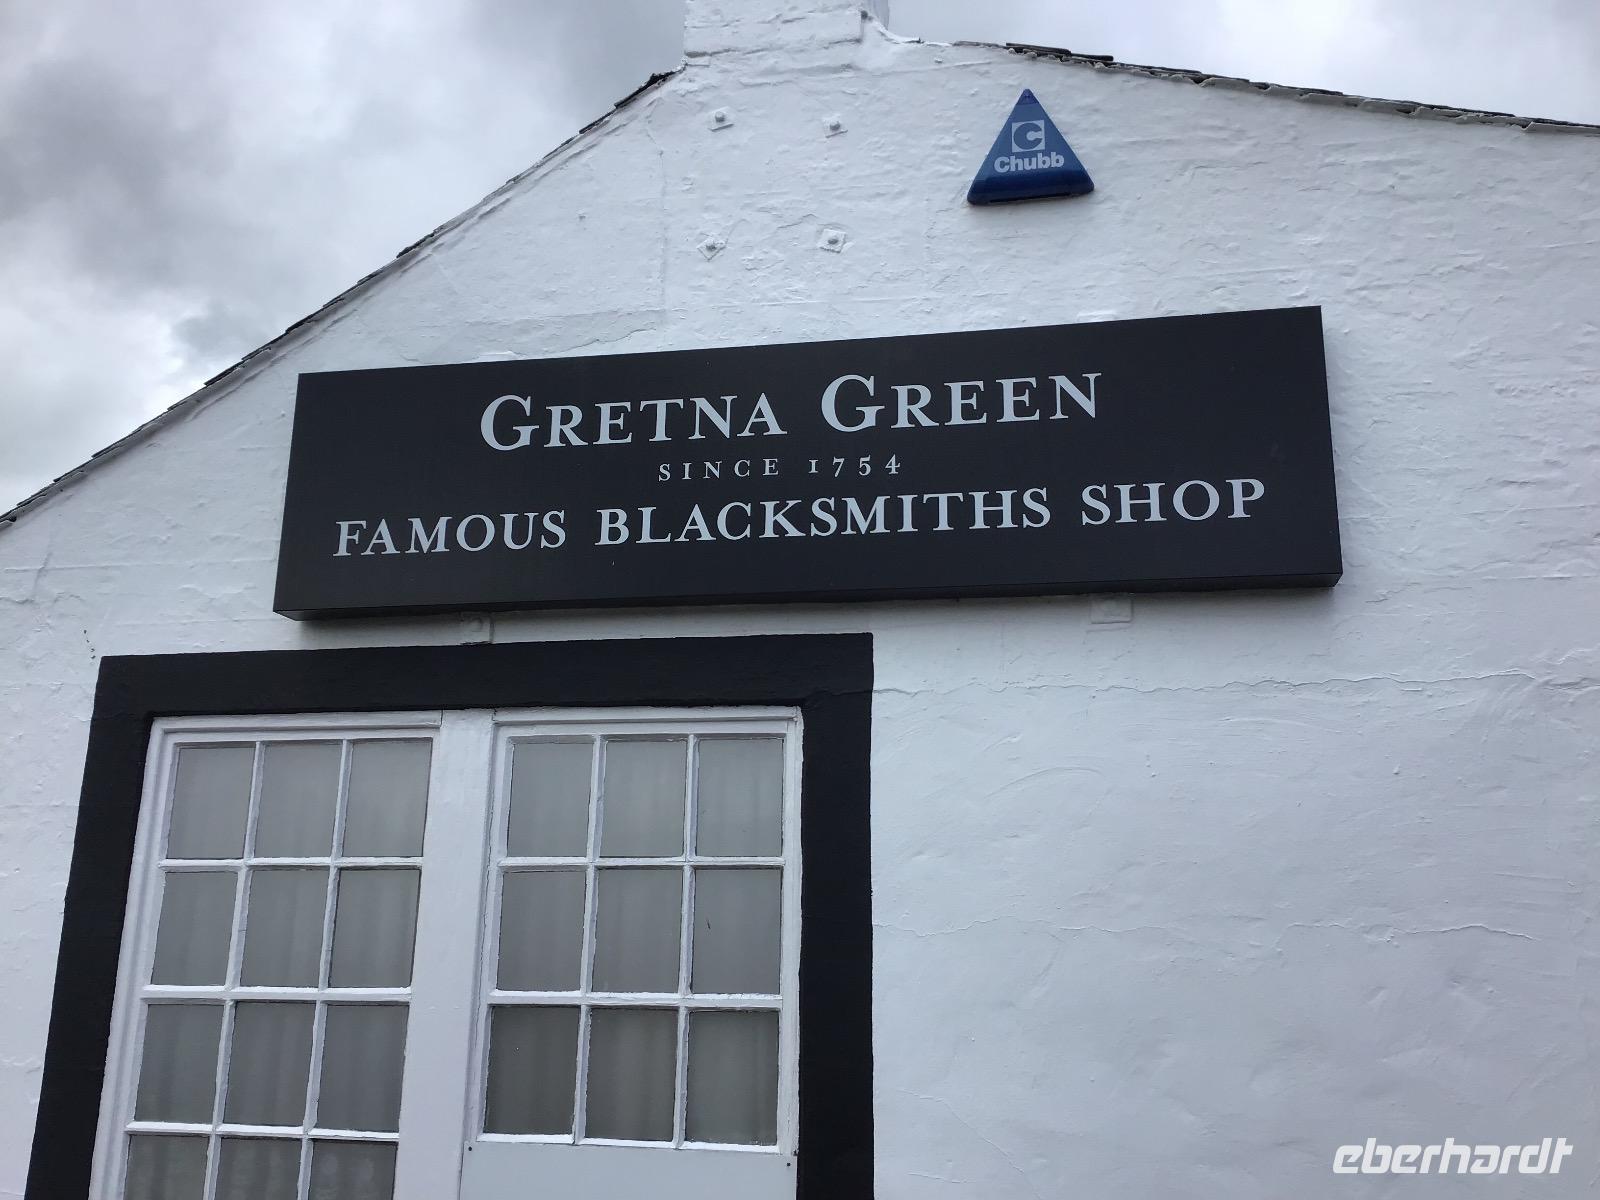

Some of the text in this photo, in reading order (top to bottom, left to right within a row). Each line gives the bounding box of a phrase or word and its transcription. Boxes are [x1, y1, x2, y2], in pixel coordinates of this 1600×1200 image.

[994, 151, 1065, 173] Chubb
[480, 372, 1102, 451] GRETNA GREEN
[658, 454, 901, 482] SINCE 1754
[333, 478, 1266, 557] FAMOUS BLACKSMITHS SHOP
